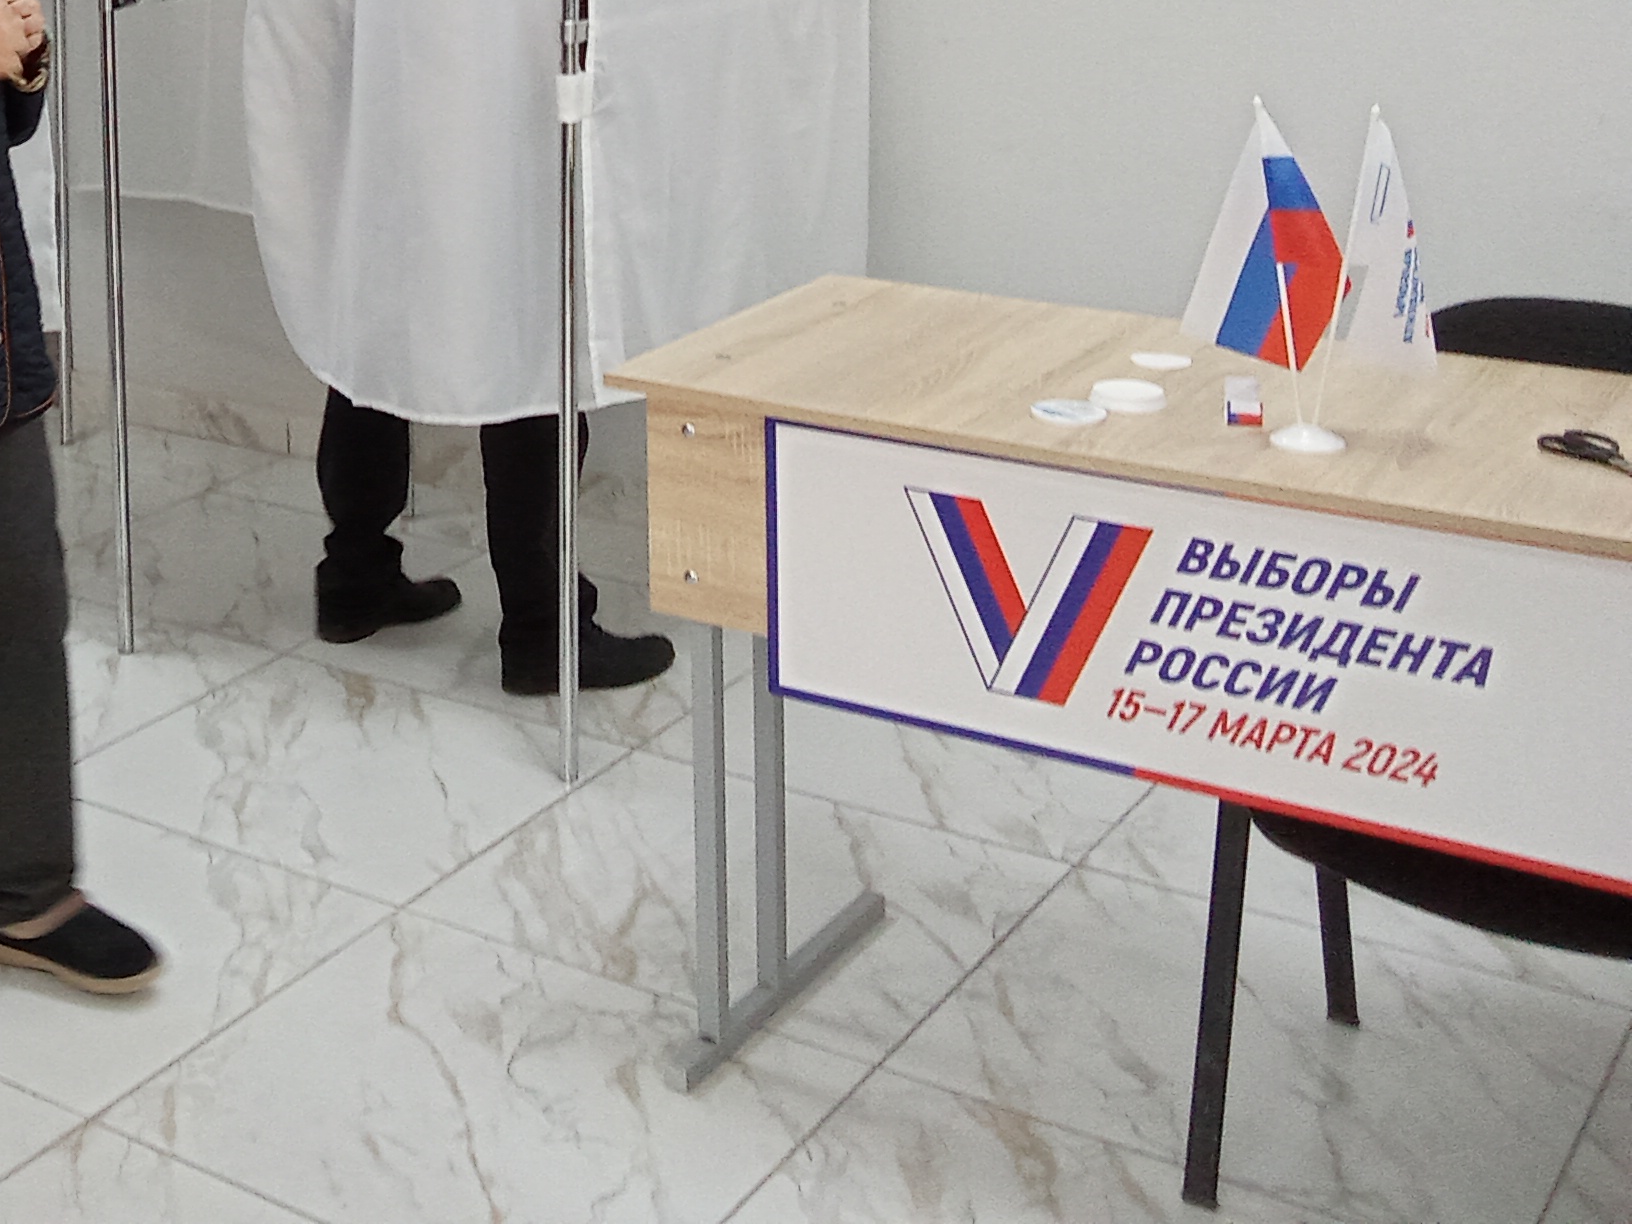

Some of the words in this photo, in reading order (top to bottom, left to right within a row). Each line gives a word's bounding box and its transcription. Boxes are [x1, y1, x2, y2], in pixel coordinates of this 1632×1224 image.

[1176, 536, 1421, 614] ВЫБОРЫ
[1124, 639, 1339, 714] РОССИИ
[1149, 587, 1495, 689] ПРЕЗИДЕНТА
[1207, 709, 1338, 767] МАРТА
[1342, 737, 1442, 789] 2024
